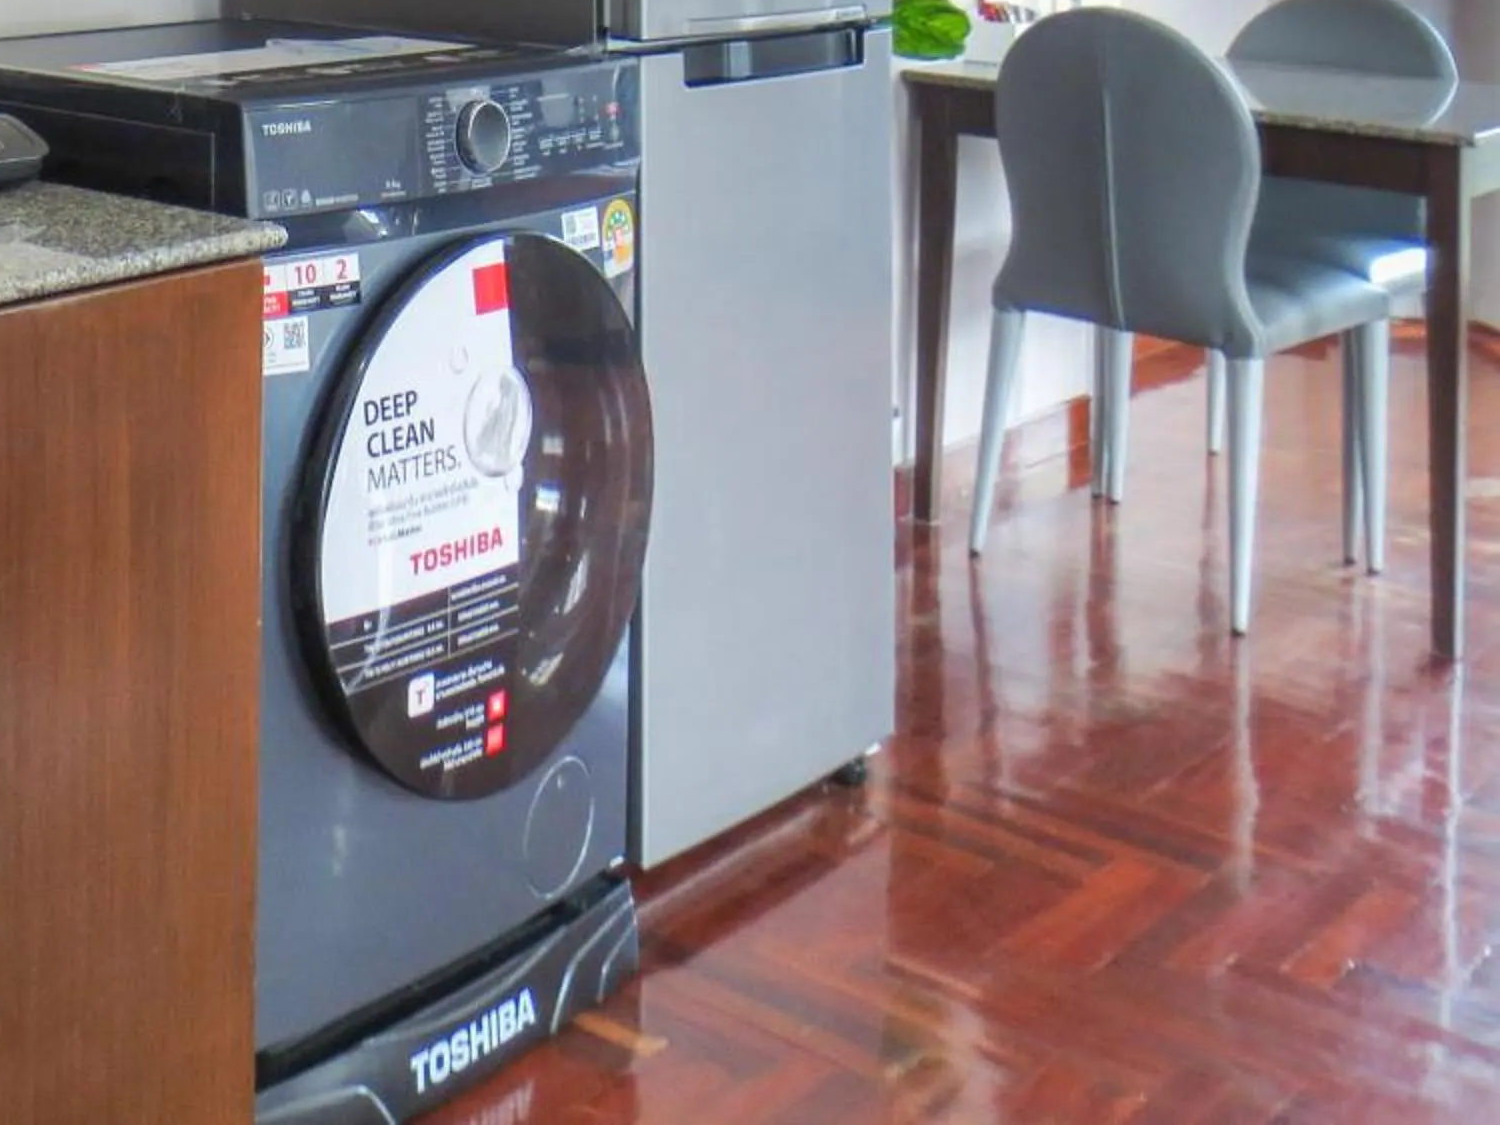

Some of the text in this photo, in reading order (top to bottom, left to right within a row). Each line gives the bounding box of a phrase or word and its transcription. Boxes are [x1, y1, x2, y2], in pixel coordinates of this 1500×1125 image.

[261, 120, 312, 136] TOSHIBA
[295, 263, 317, 285] 10
[335, 258, 348, 280] 2
[363, 390, 418, 426] DEEP
[367, 417, 435, 458] CLEAN
[367, 445, 462, 493] MATTERS.
[409, 526, 504, 576] TOSHIBA
[409, 986, 536, 1095] TOSHIBA
